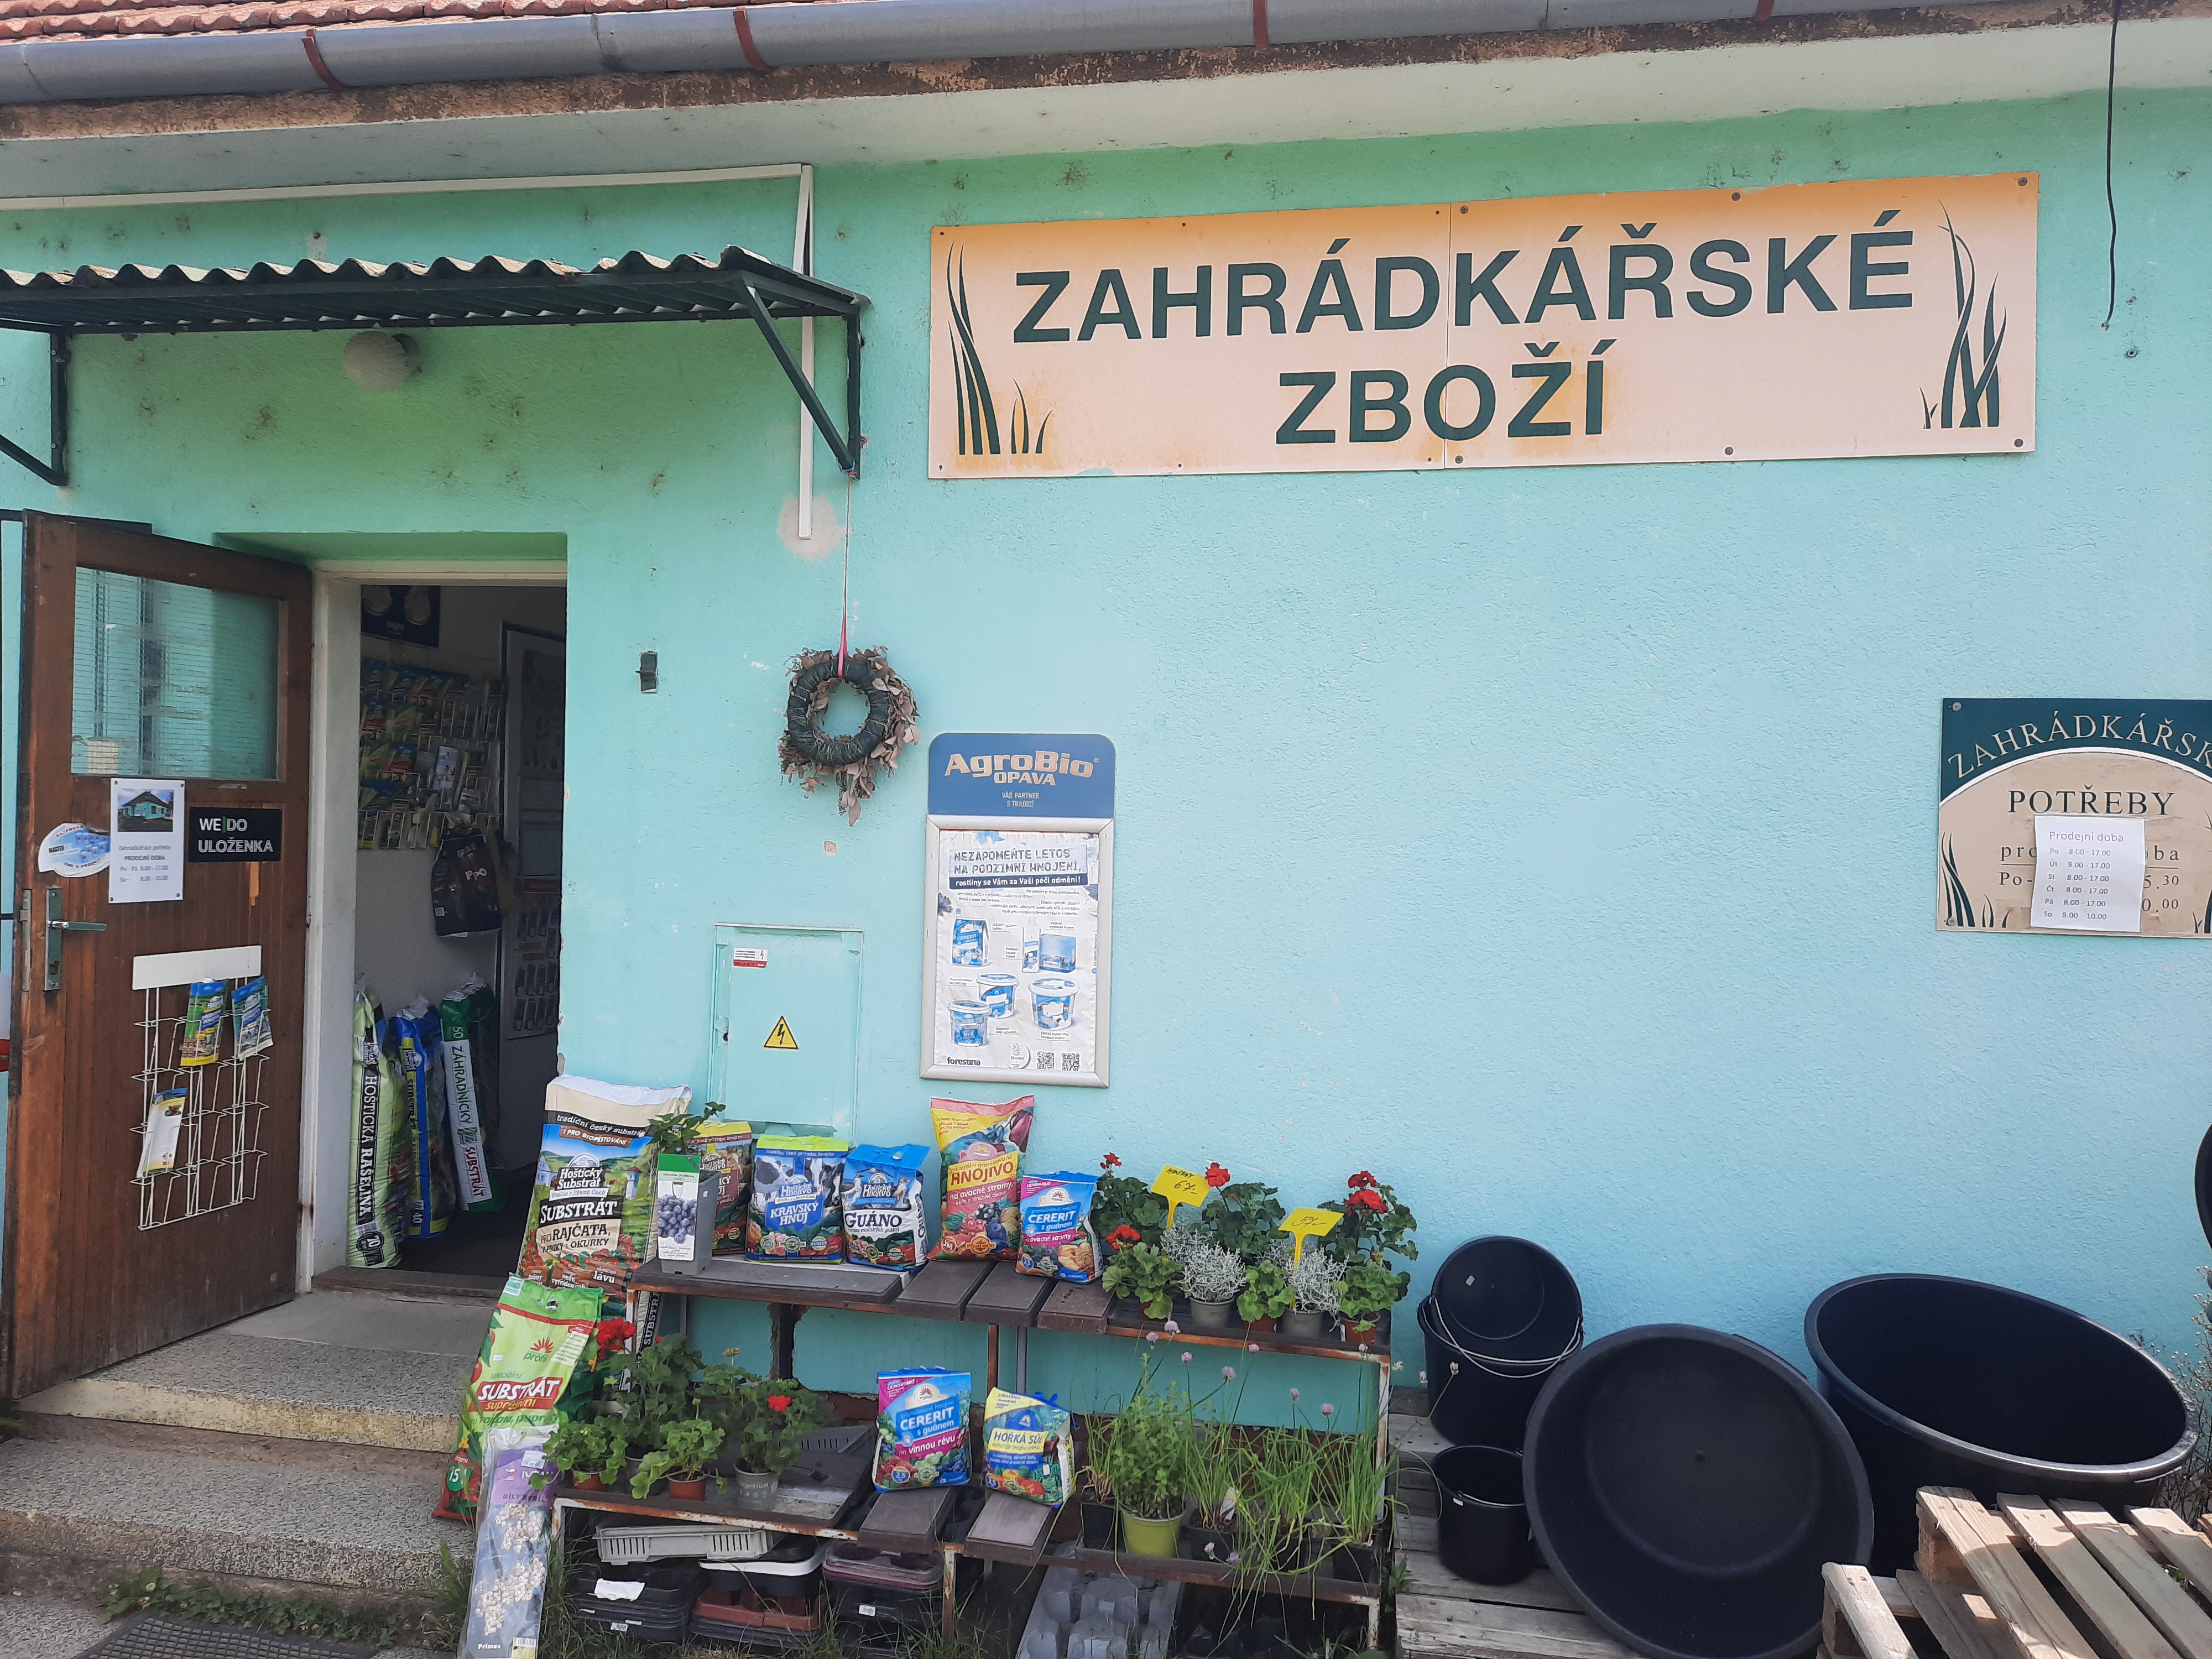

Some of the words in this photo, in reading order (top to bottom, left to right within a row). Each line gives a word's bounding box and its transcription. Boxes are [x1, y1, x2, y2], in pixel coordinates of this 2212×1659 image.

[1012, 208, 1916, 345] ZAHRÁDKÁŘSKÉ
[1275, 339, 1618, 445] ZBOŽÍ
[945, 750, 1094, 778] AgroBio
[994, 771, 1056, 786] OPAVA
[2007, 784, 2175, 815] POTŘEBY
[2049, 831, 2094, 842] Prodejní
[2098, 833, 2124, 842] doba
[199, 837, 274, 853] ULOŽENKA
[954, 848, 1031, 862] NEZAPOMEŇTE
[1035, 849, 1070, 859] LETOS
[954, 864, 968, 874] NA
[972, 862, 1026, 874] PODZIMNÍ
[453, 1027, 463, 1039] 50
[557, 1114, 589, 1128] tradiční
[590, 1124, 613, 1133] český
[582, 1133, 627, 1145] BIOPĚSTOVÁNÍ
[465, 1146, 484, 1197] SUBSTRÁT
[560, 1167, 603, 1179] Hoštický
[951, 1161, 1014, 1186] HNOJIVO
[359, 1147, 374, 1215] RAŠELINA
[540, 1198, 617, 1224] SUBSTRÁT
[770, 1201, 819, 1219] KRAVSKÝ
[1028, 1211, 1076, 1224] CERERIT
[845, 1211, 902, 1228] GUÁNO
[1046, 1221, 1072, 1232] guánem
[552, 1223, 611, 1241] RAJČATA,
[367, 1236, 380, 1248] 70
[570, 1239, 609, 1249] OKURKY
[593, 1271, 615, 1284] lávu
[490, 1370, 524, 1380] speciální
[478, 1377, 560, 1400] SUBSTRÁT
[900, 1406, 954, 1431] CERERIT
[923, 1420, 954, 1436] guánem
[909, 1441, 935, 1454] vinnou
[938, 1434, 956, 1447] révu
[994, 1431, 1026, 1443] HOŘKÁ
[449, 1467, 461, 1483] 15
